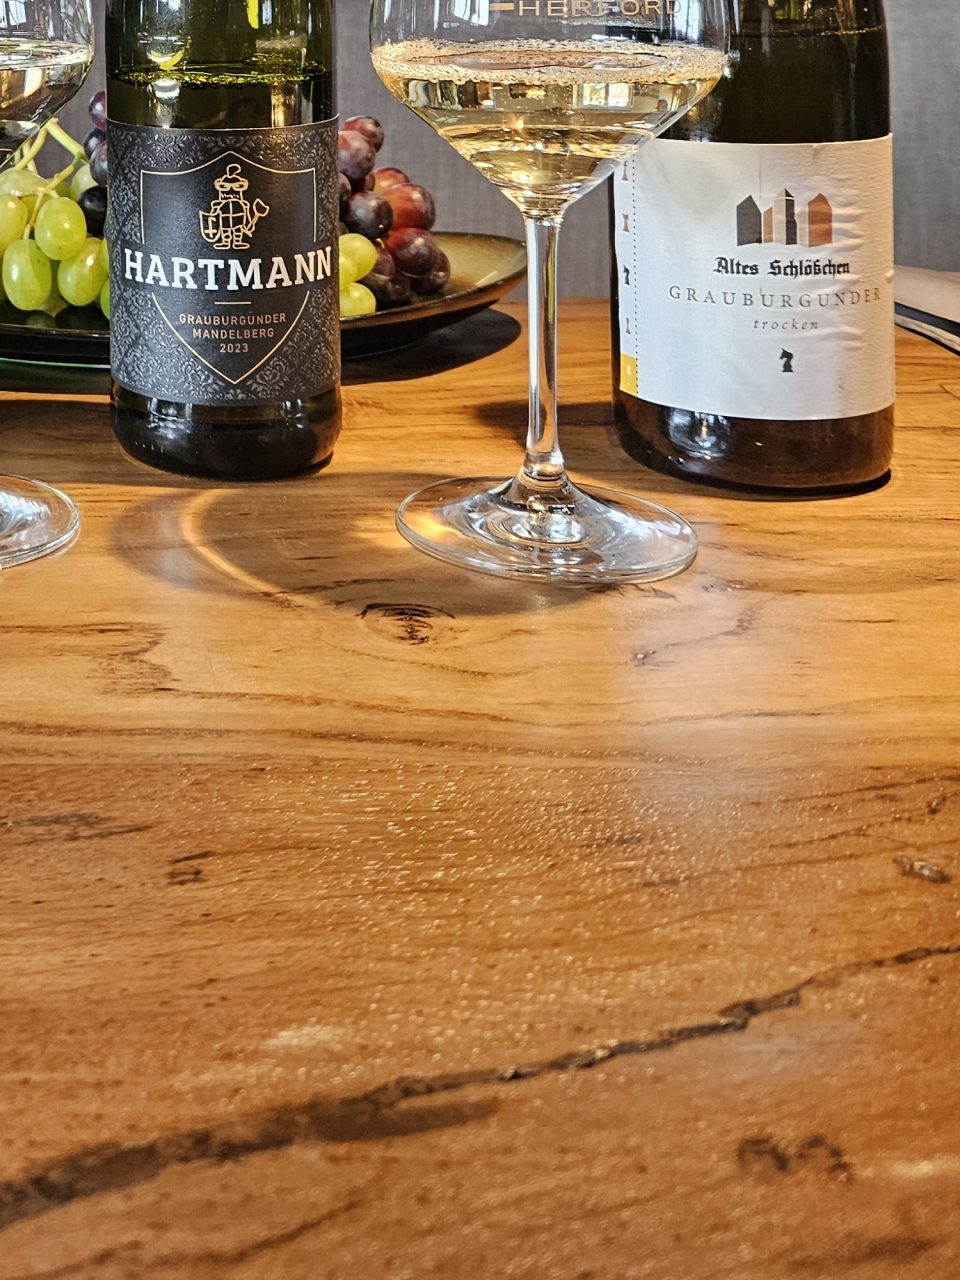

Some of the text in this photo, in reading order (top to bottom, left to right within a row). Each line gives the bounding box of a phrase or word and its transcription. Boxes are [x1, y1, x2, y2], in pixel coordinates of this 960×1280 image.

[518, 0, 682, 17] HERFORD
[124, 246, 332, 291] HARTMANN
[713, 257, 759, 276] Altes
[669, 285, 881, 307] GRAUBURGUNDER
[179, 312, 287, 326] GRAUBURGUNDER
[754, 319, 819, 330] trocken
[192, 328, 275, 341] MANDELBERG
[219, 342, 249, 354] 2023
